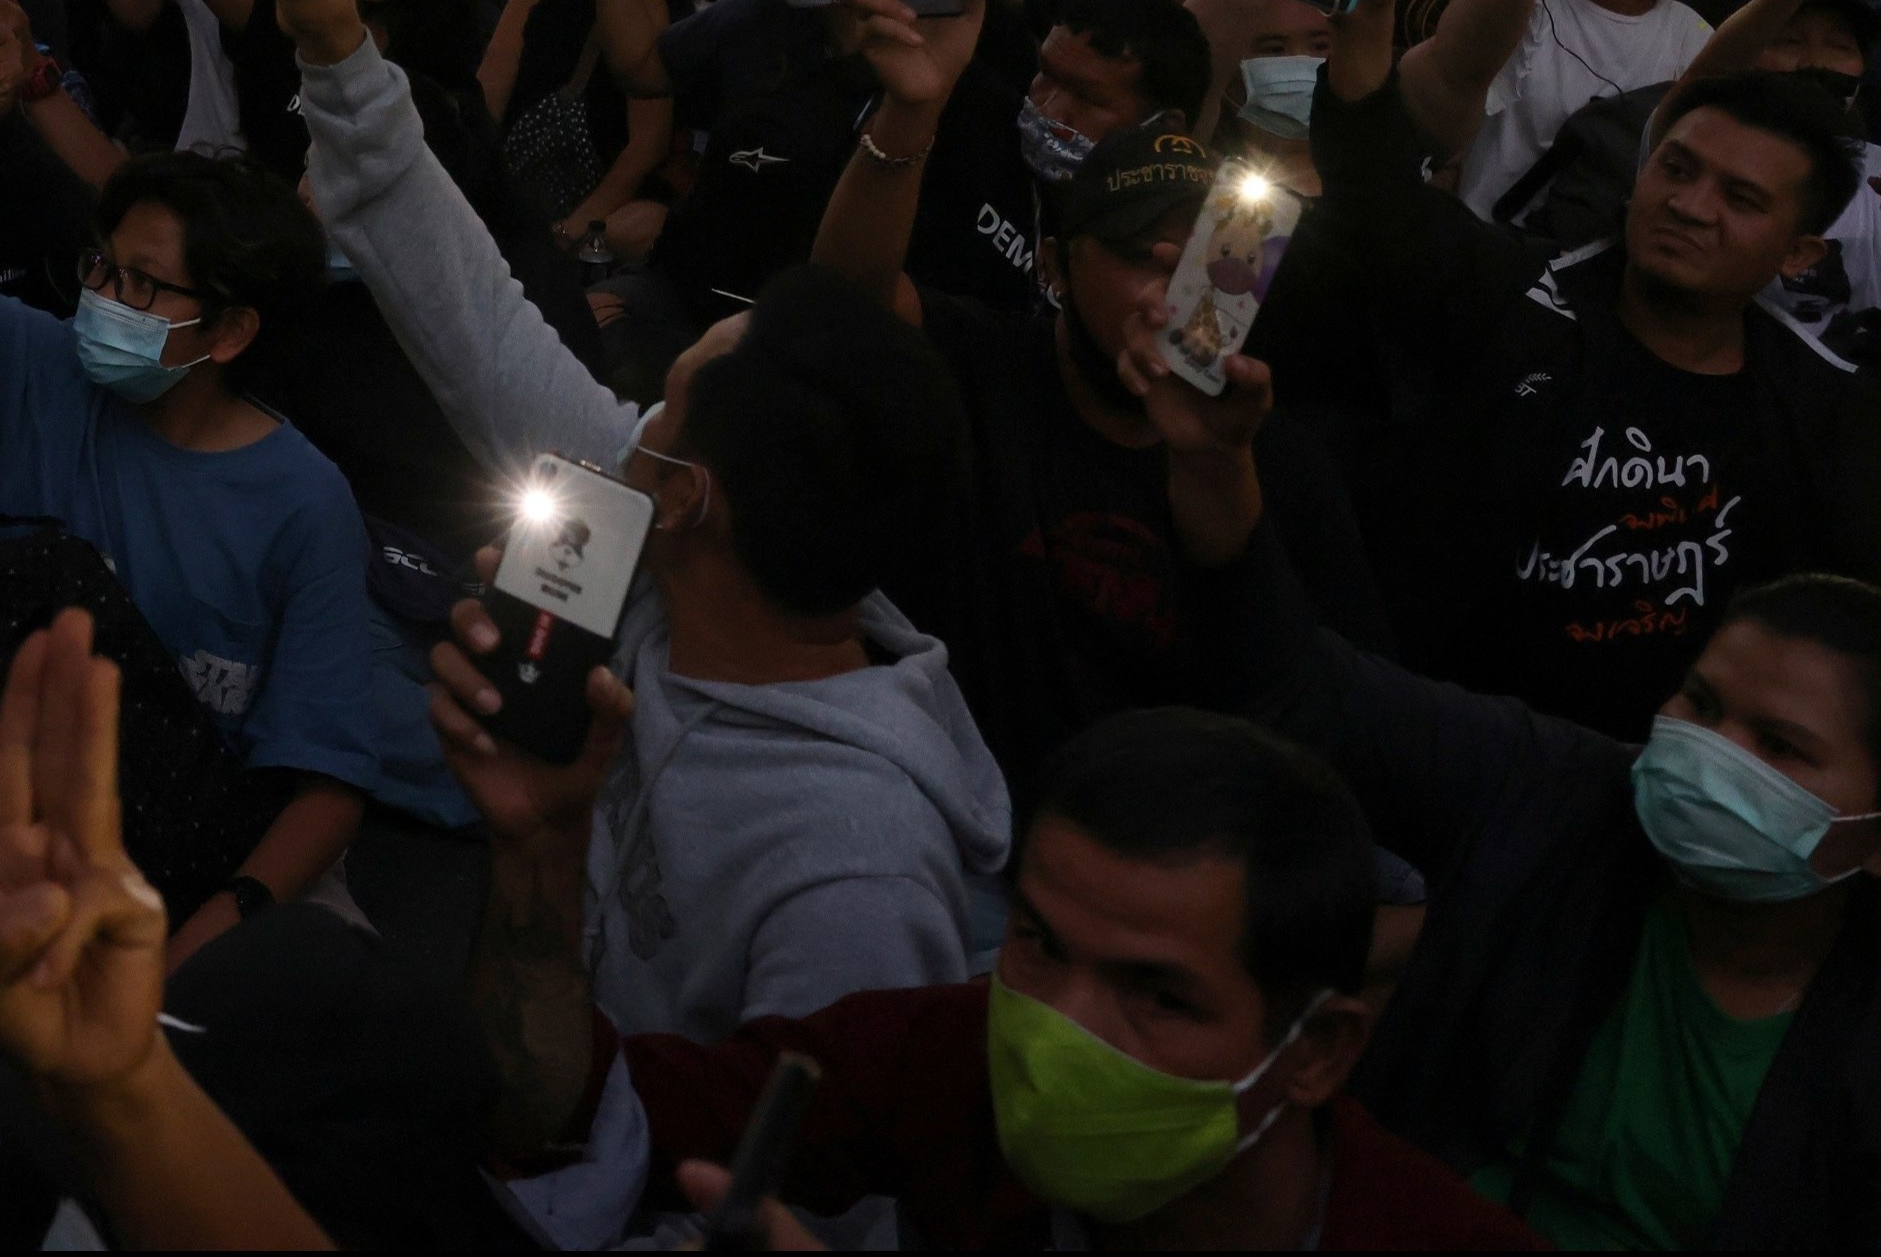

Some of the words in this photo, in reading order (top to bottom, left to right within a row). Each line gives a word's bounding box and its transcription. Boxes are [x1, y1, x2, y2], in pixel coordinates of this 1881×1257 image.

[1561, 426, 1710, 489] ศักดินา
[1516, 495, 1742, 607] ประชาราษฎร์
